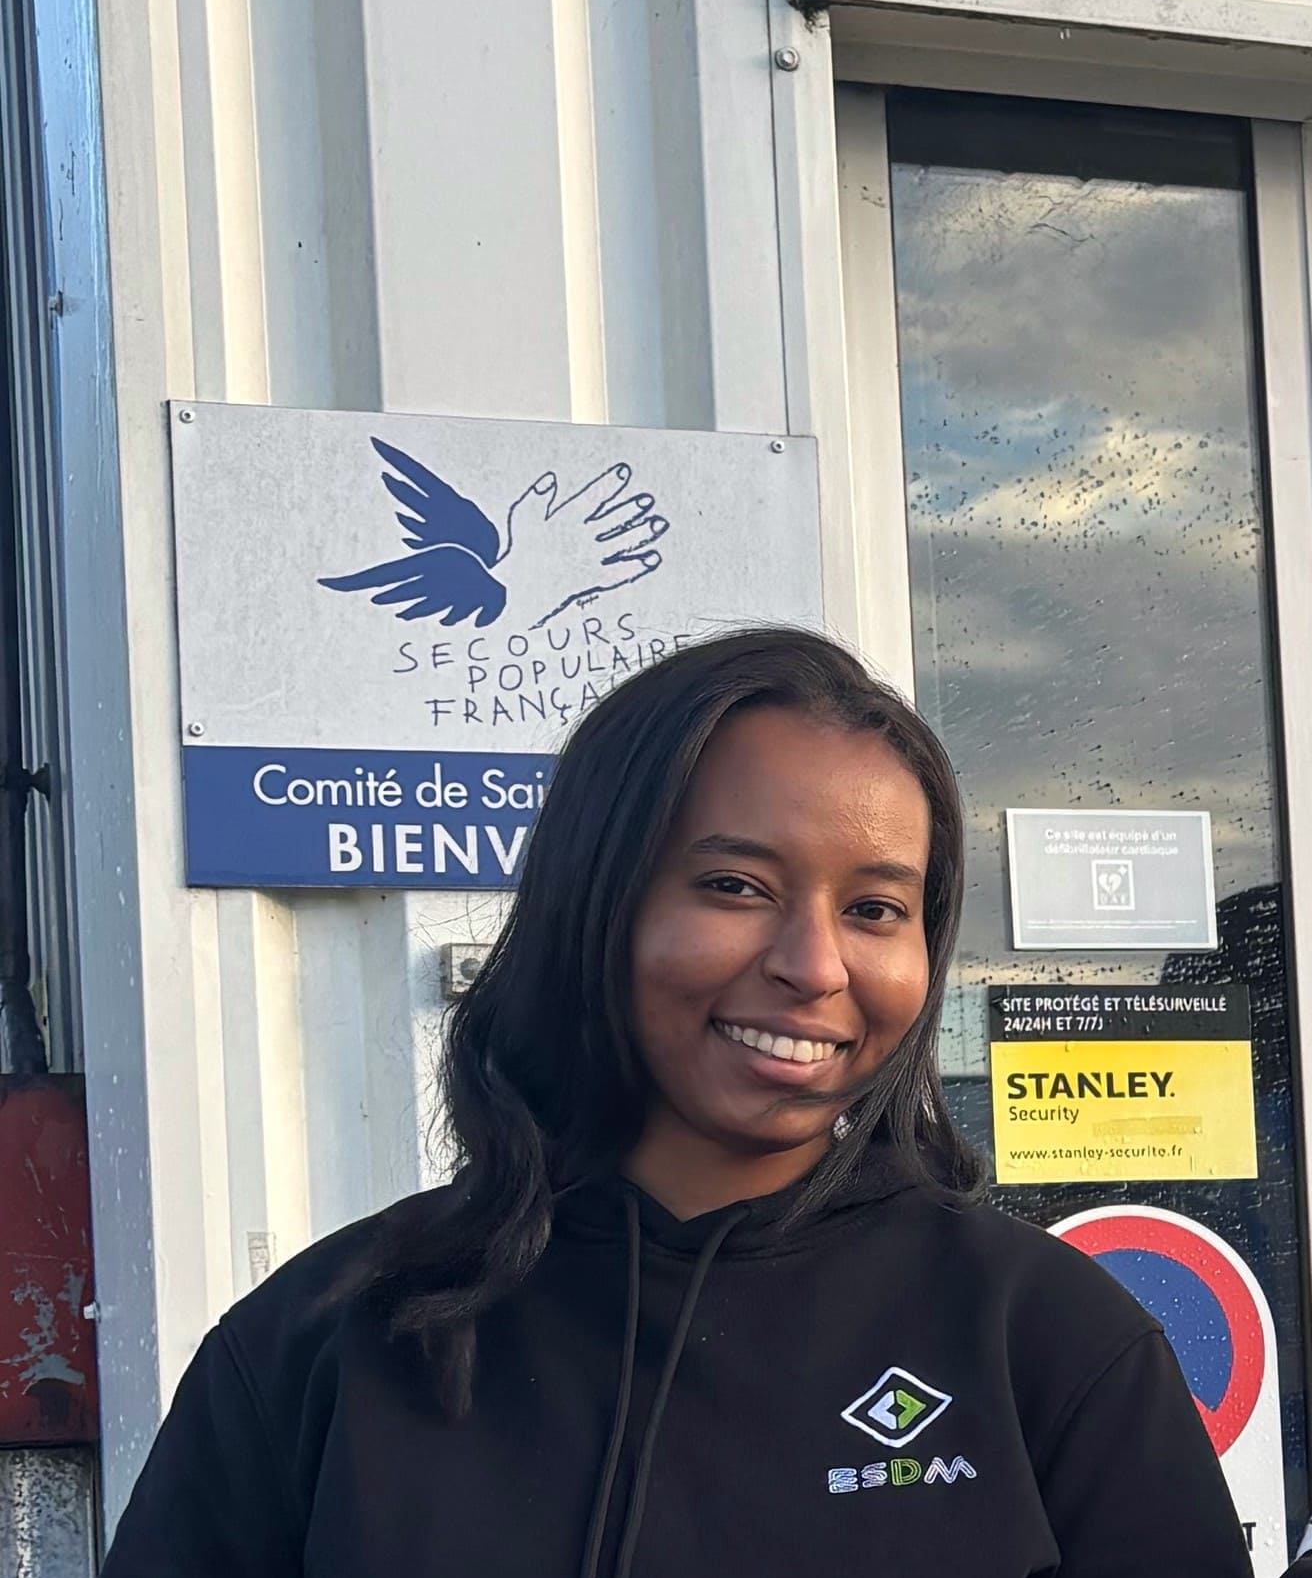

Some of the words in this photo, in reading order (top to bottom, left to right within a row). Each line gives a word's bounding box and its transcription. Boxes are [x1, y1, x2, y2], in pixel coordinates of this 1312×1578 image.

[393, 612, 636, 673] SECOURS
[468, 634, 692, 693] POPULAIRE
[253, 762, 403, 809] Comité
[416, 762, 467, 809] de
[481, 769, 544, 809] Sai
[328, 823, 528, 875] BIENV
[1002, 997, 1031, 1012] SITE
[1035, 994, 1099, 1012] PROTÉGÉ
[1104, 997, 1120, 1012] ET
[1124, 994, 1227, 1013] TÉLÉSURVEILLÉ
[1003, 1017, 1052, 1033] 24/24H
[1056, 1017, 1071, 1031] ET
[1009, 1105, 1079, 1124] Security
[827, 1455, 977, 1494] ESDM
